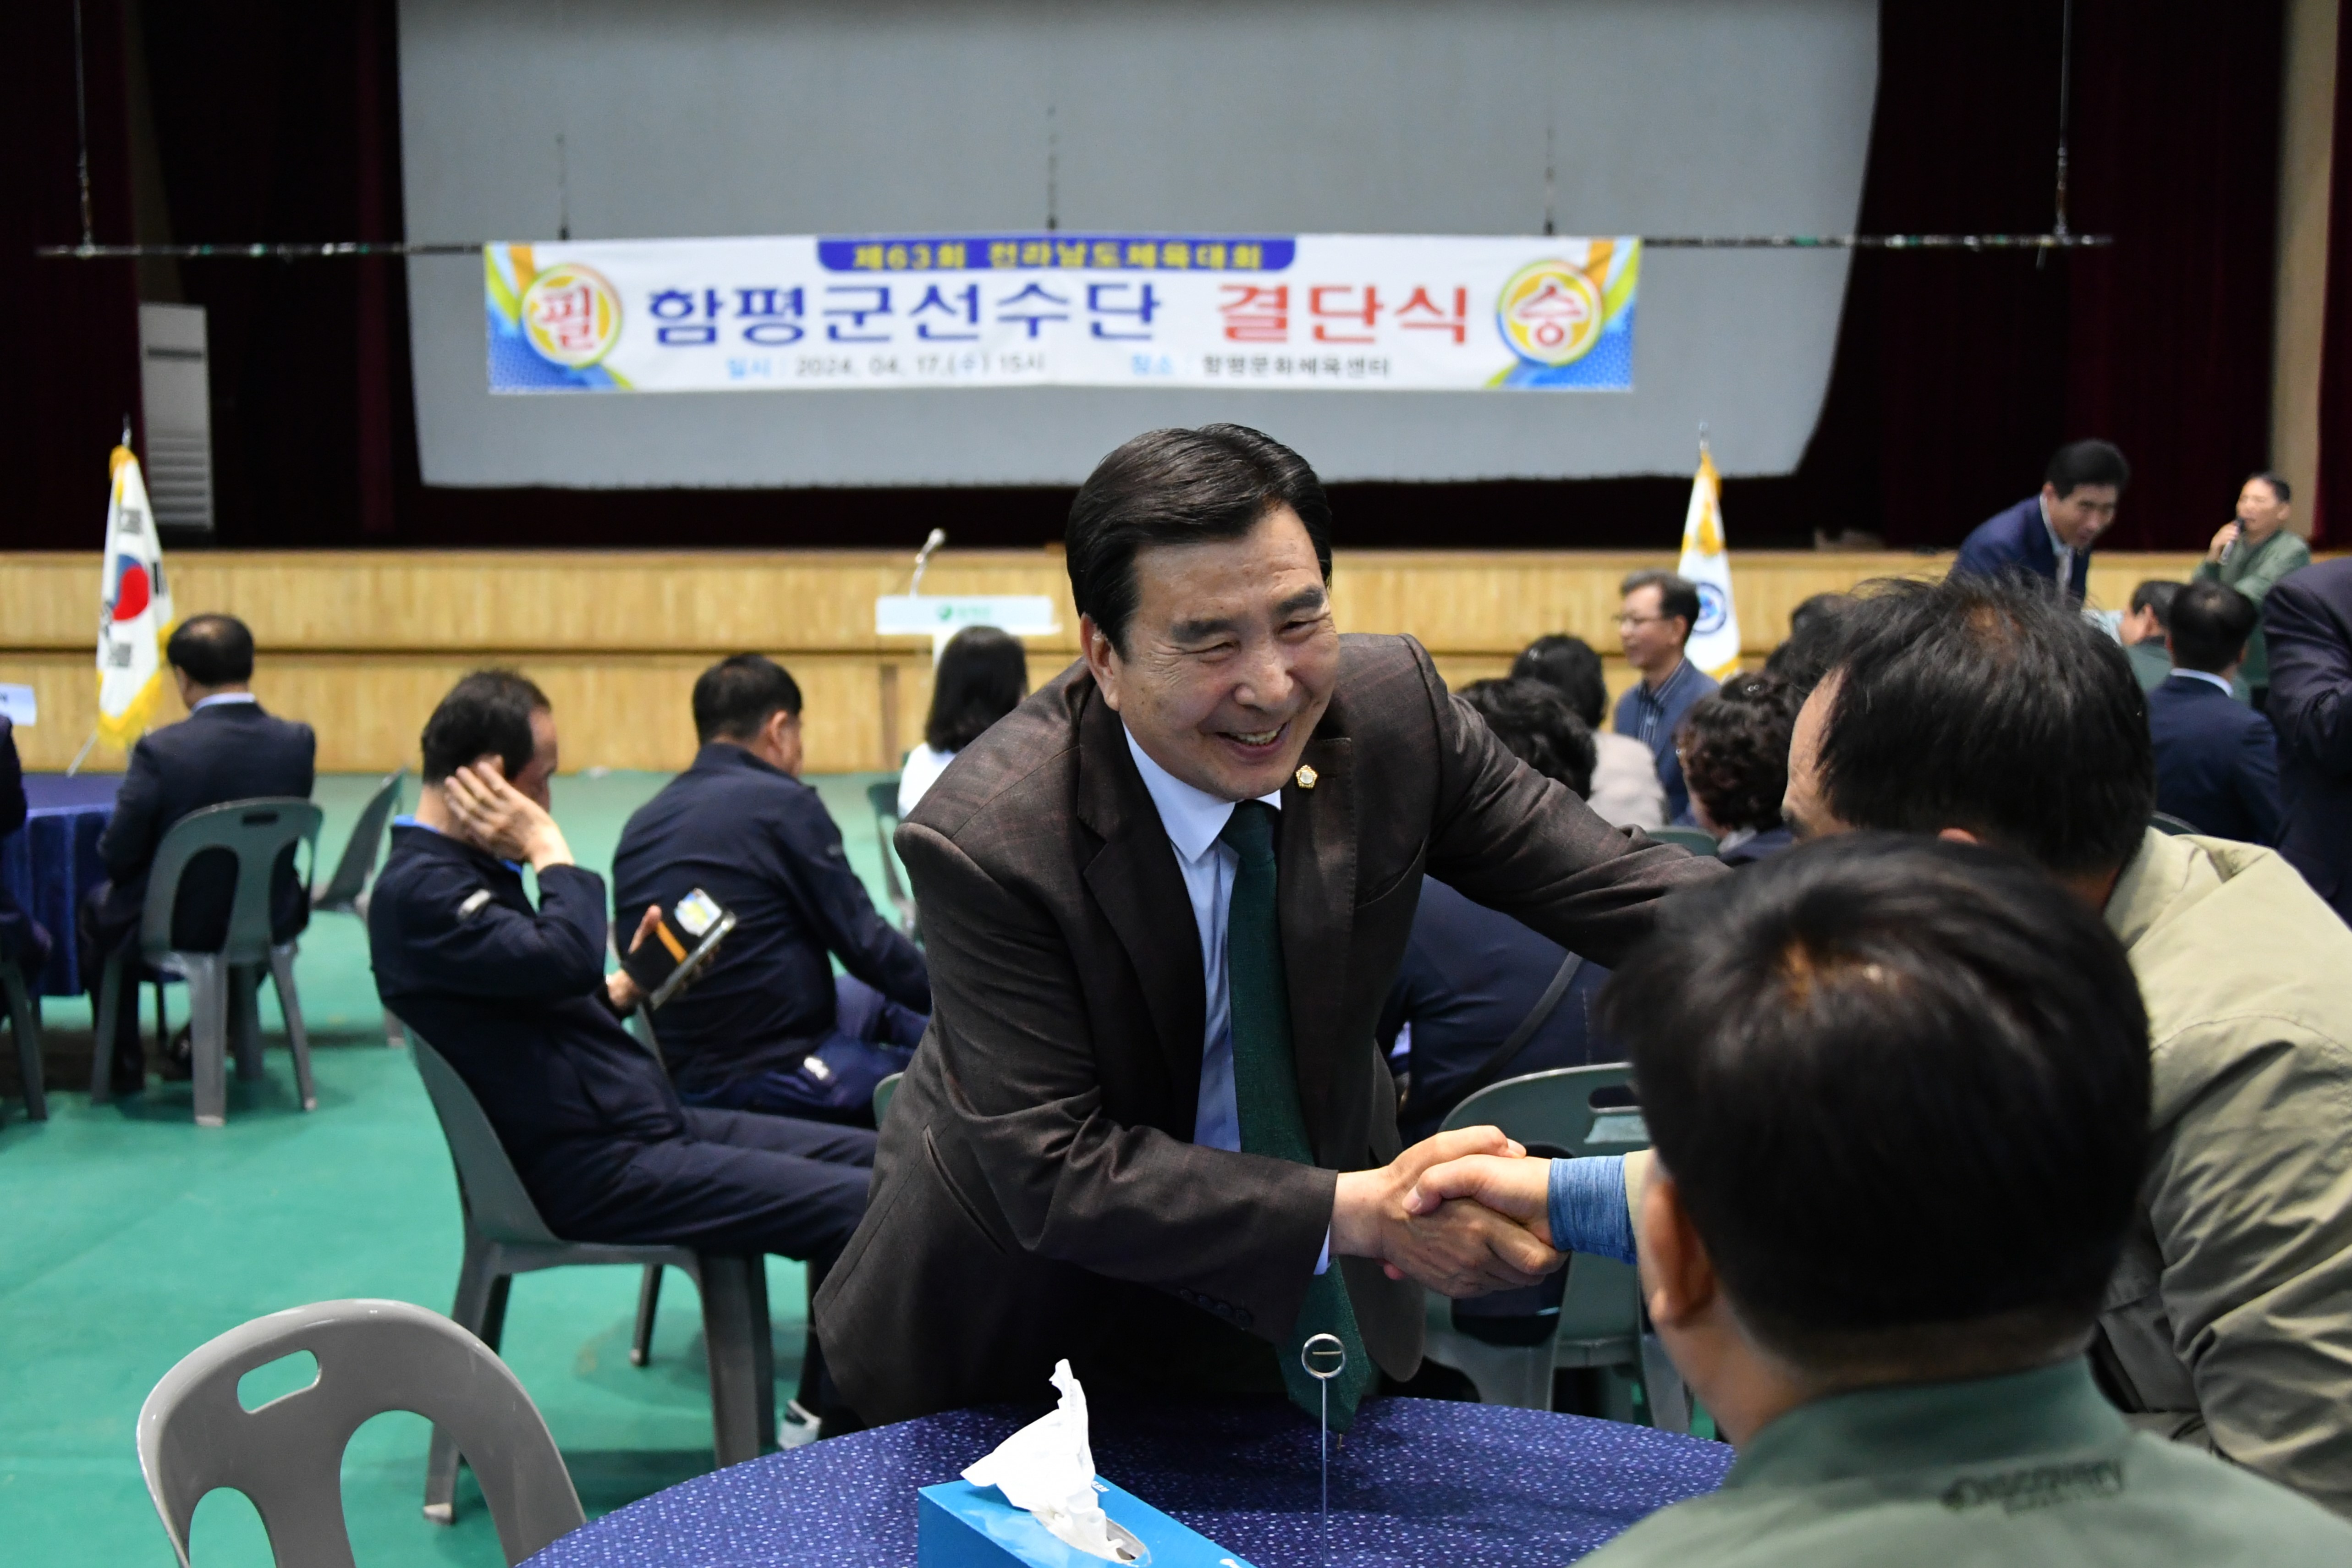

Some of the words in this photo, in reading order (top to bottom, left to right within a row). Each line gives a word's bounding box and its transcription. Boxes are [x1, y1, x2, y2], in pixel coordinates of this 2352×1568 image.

[854, 243, 965, 270] 제63회
[543, 285, 597, 353] 필
[649, 283, 1161, 345] 함평군선수단
[1218, 282, 1467, 346] 결단식
[1520, 284, 1588, 348] 승
